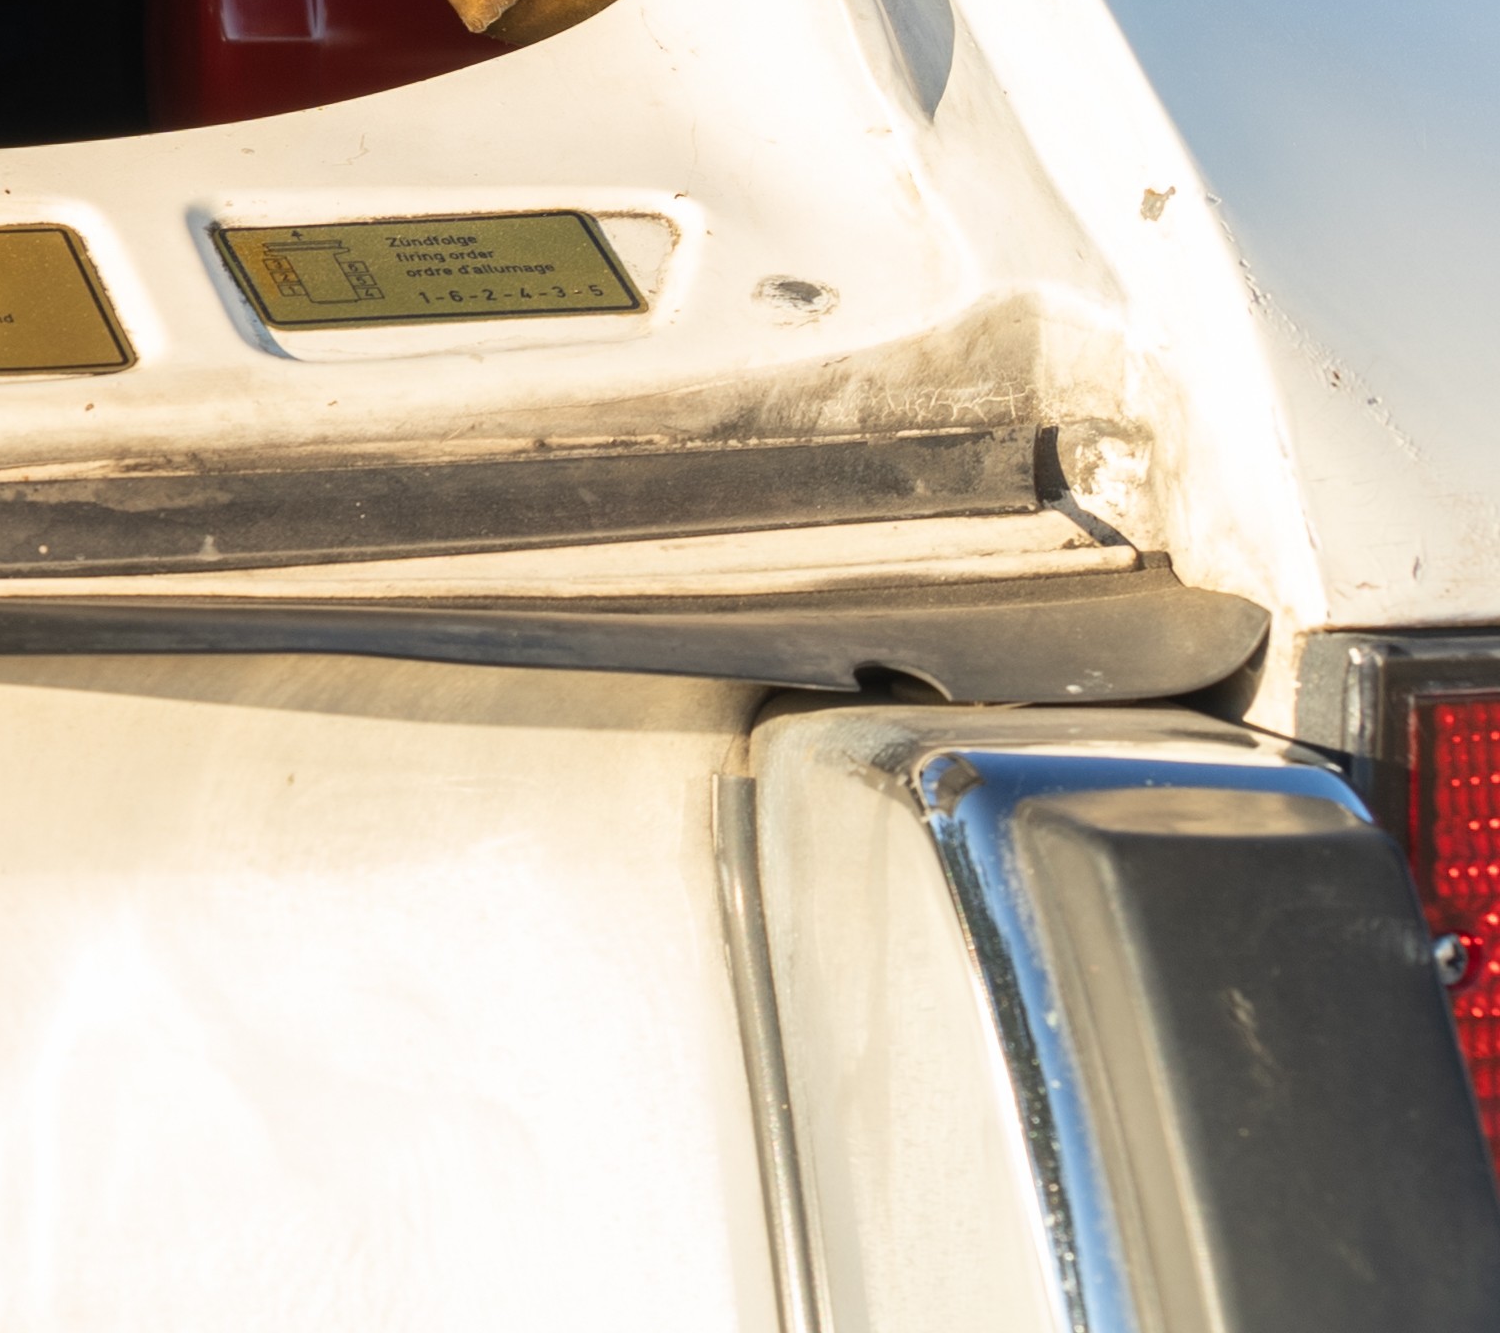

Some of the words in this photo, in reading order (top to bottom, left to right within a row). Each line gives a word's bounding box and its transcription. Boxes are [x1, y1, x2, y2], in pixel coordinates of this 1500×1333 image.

[396, 251, 446, 263] firing
[449, 249, 494, 261] order
[406, 267, 452, 278] ordre
[458, 263, 555, 276] d'allumage
